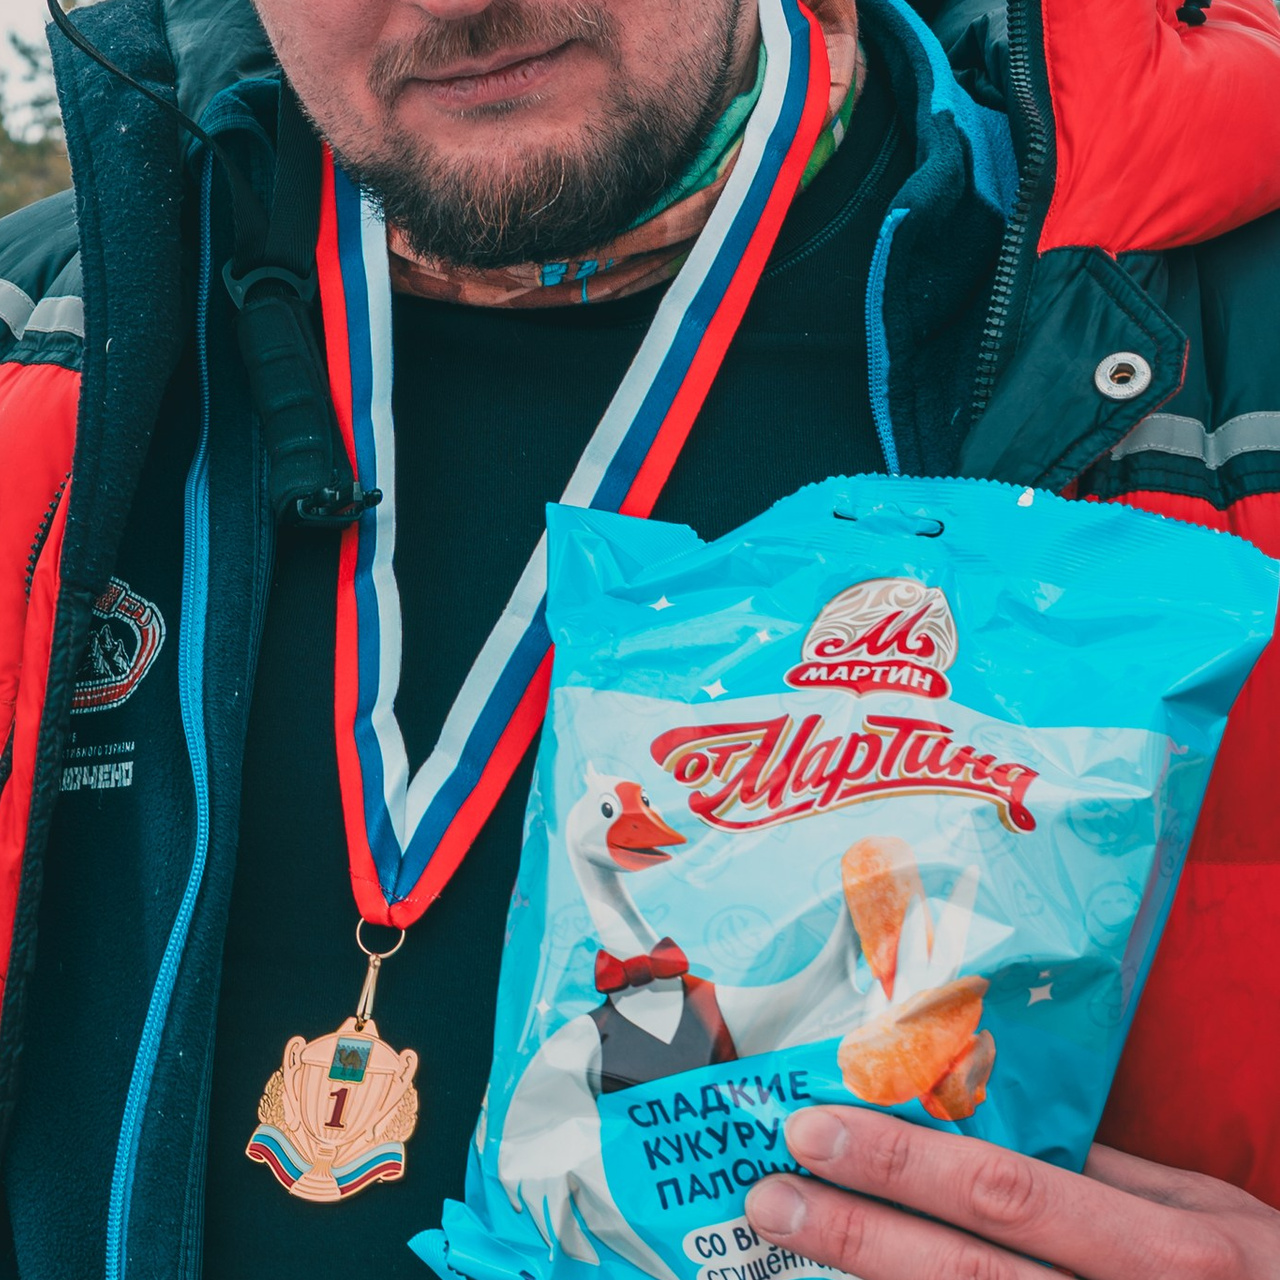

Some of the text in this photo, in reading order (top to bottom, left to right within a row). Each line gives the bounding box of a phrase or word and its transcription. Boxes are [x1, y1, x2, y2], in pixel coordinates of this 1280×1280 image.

[799, 665, 933, 693] МАРТИН
[325, 1088, 349, 1128] 1
[627, 1070, 812, 1128] СЛАДКИЕ
[656, 1158, 806, 1210] ПАЛО
